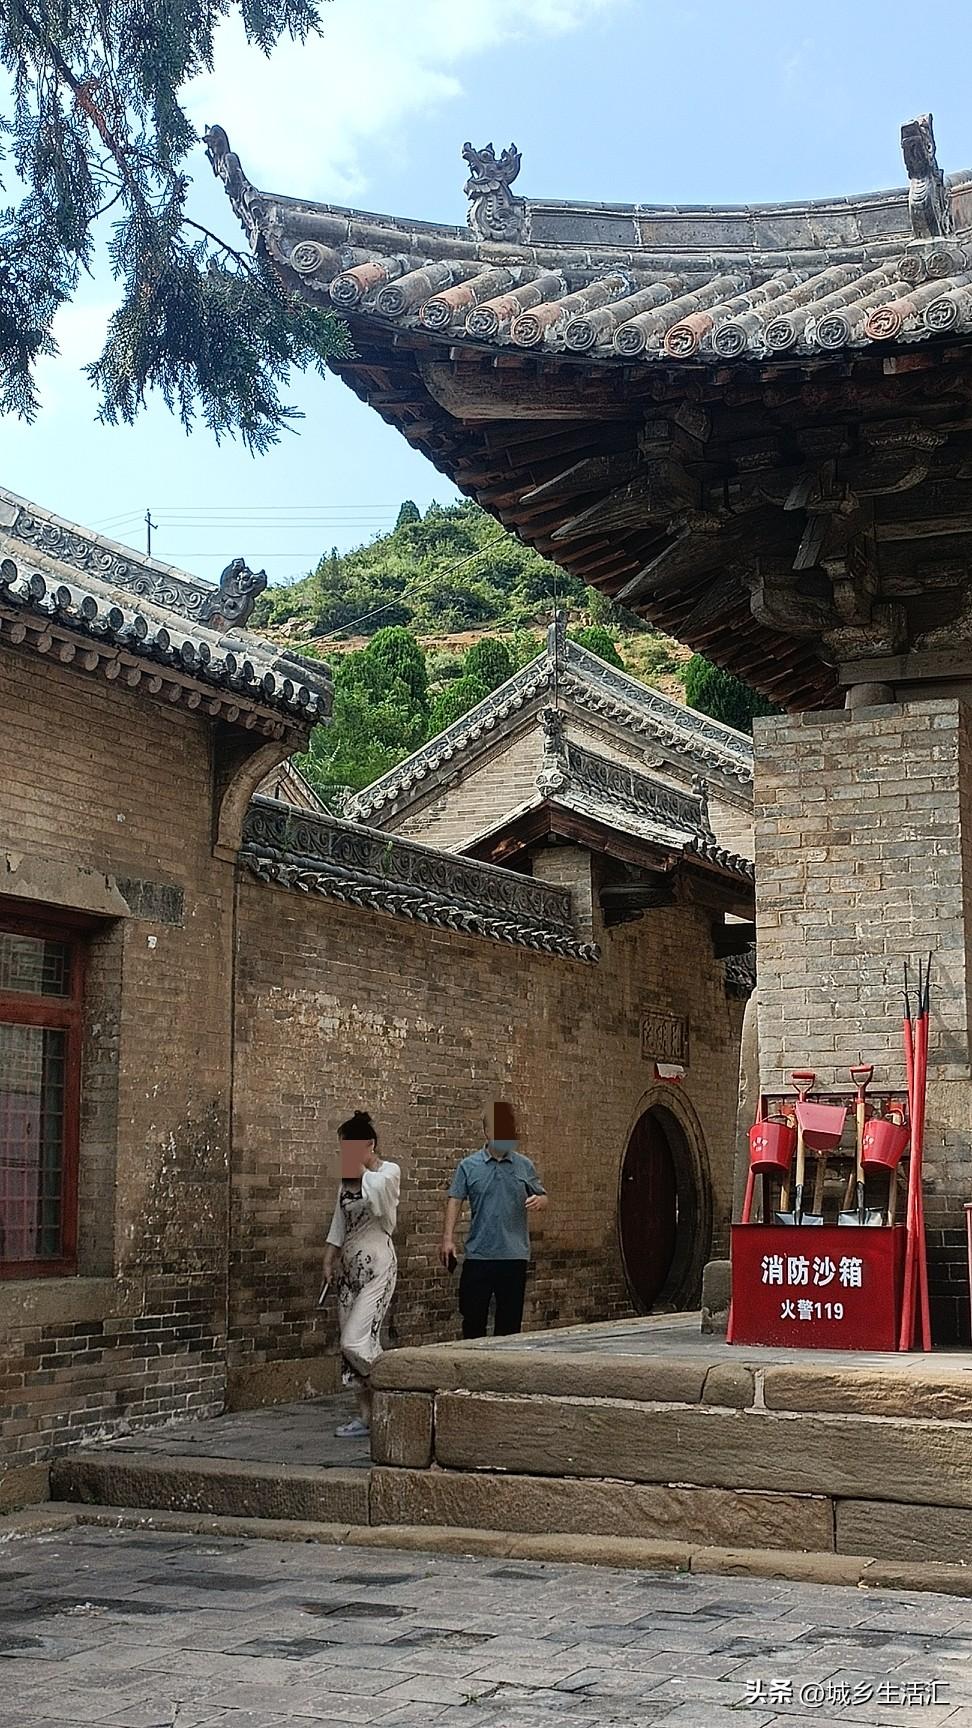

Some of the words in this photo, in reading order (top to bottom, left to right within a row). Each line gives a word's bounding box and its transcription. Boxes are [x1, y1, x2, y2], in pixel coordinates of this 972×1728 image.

[760, 1254, 863, 1287] 消防沙箱
[780, 1299, 844, 1320] 火警119
